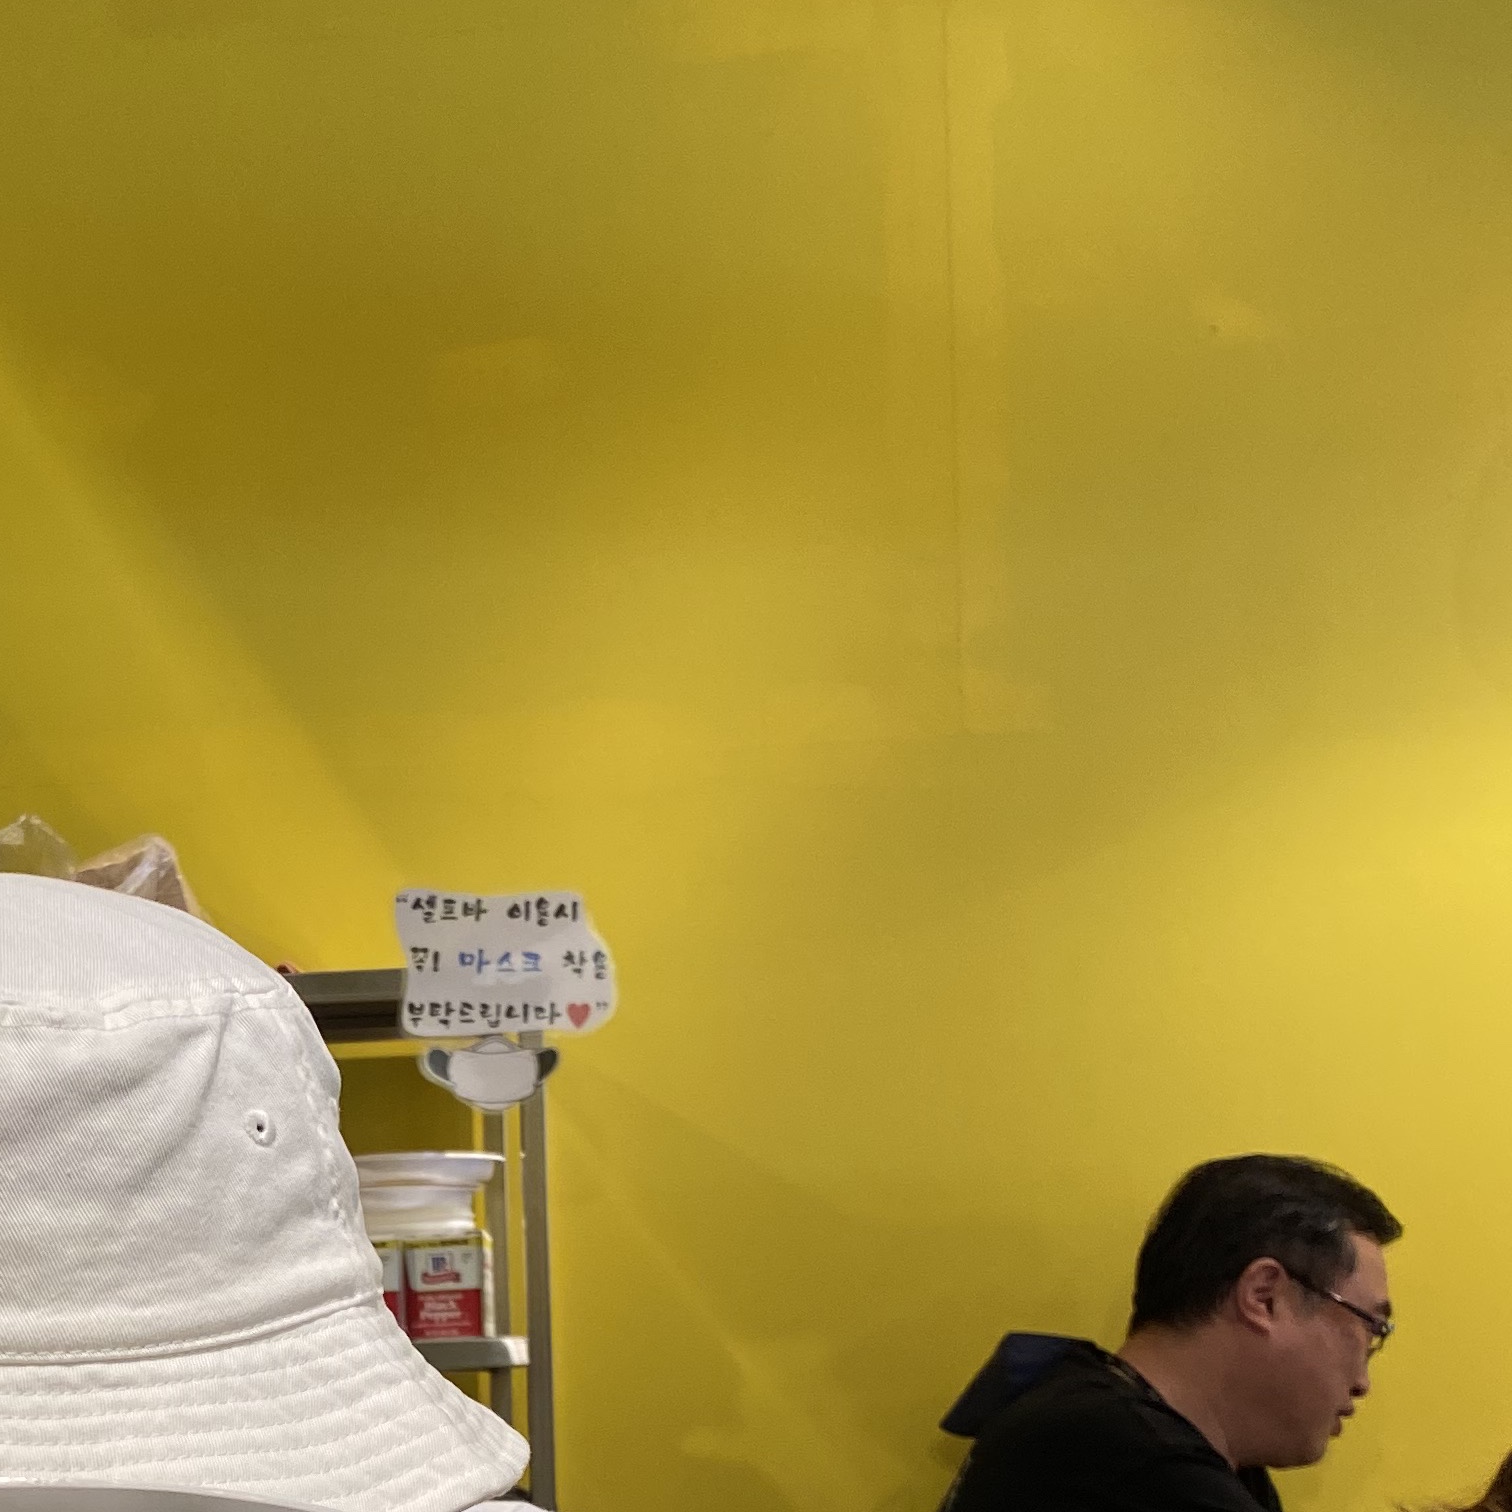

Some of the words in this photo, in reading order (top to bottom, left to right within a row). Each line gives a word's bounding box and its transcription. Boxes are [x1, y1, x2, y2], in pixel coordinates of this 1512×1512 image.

[507, 897, 579, 927] 이용시
[458, 948, 542, 975] 마스크
[562, 950, 607, 980] 착용
[408, 1001, 563, 1029] 부탁드립니다
